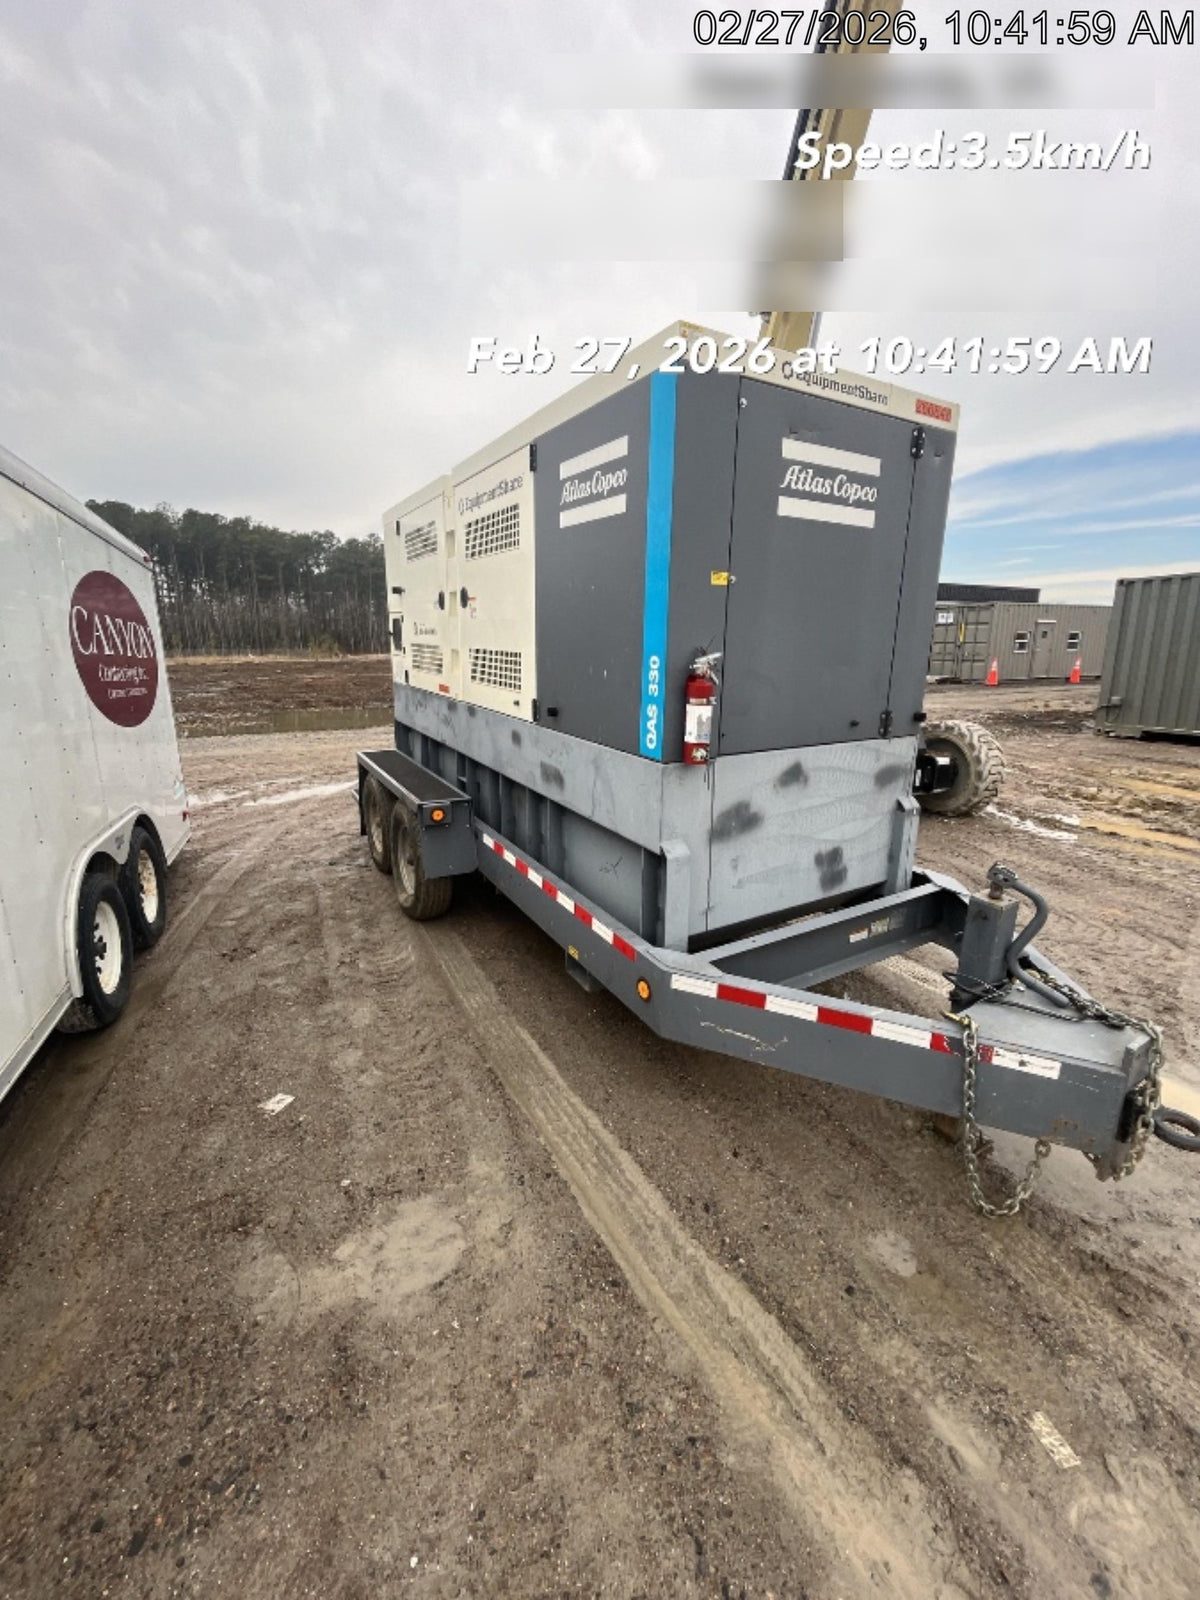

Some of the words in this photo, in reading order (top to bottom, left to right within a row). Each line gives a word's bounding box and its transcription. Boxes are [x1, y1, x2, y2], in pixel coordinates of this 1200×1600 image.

[559, 480, 591, 505] Atlas
[592, 469, 628, 496] Copco
[780, 465, 833, 495] Atlas
[833, 474, 878, 504] Copco
[72, 605, 154, 658] CANYON
[648, 655, 661, 697] 330
[646, 704, 659, 750] QAS
